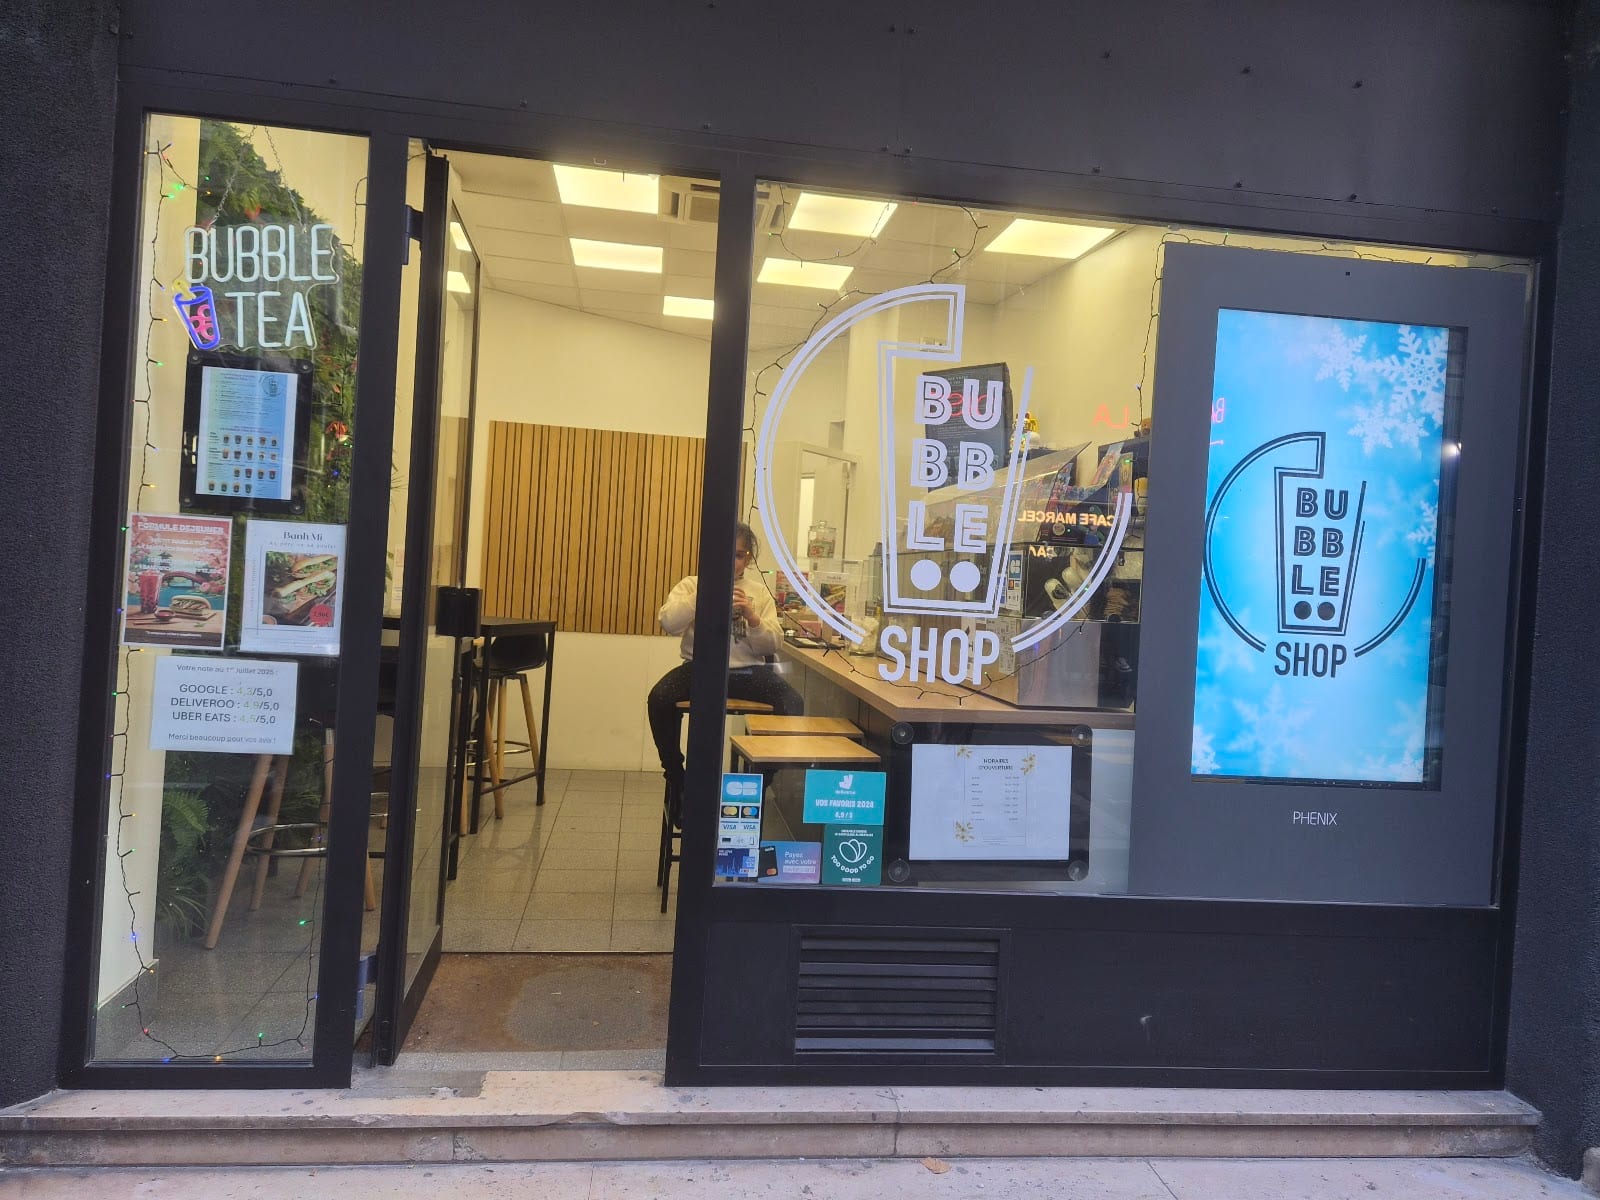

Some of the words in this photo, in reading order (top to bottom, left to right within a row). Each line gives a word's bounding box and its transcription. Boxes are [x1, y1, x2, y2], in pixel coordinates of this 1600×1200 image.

[184, 224, 336, 284] BUBBLE
[225, 291, 313, 348] TEA
[283, 531, 309, 541] Banh
[311, 533, 323, 542] Mi
[878, 625, 1000, 686] SHOP
[1274, 641, 1348, 678] SHOP
[177, 664, 196, 672] Votre
[179, 683, 228, 695] GOOGLE
[170, 697, 235, 709] DELIVEROO
[172, 711, 202, 721] UBER
[204, 712, 231, 722] EATS
[168, 733, 189, 741] Merci
[189, 734, 226, 743] beaucoup
[1293, 811, 1338, 826] PHENIX
